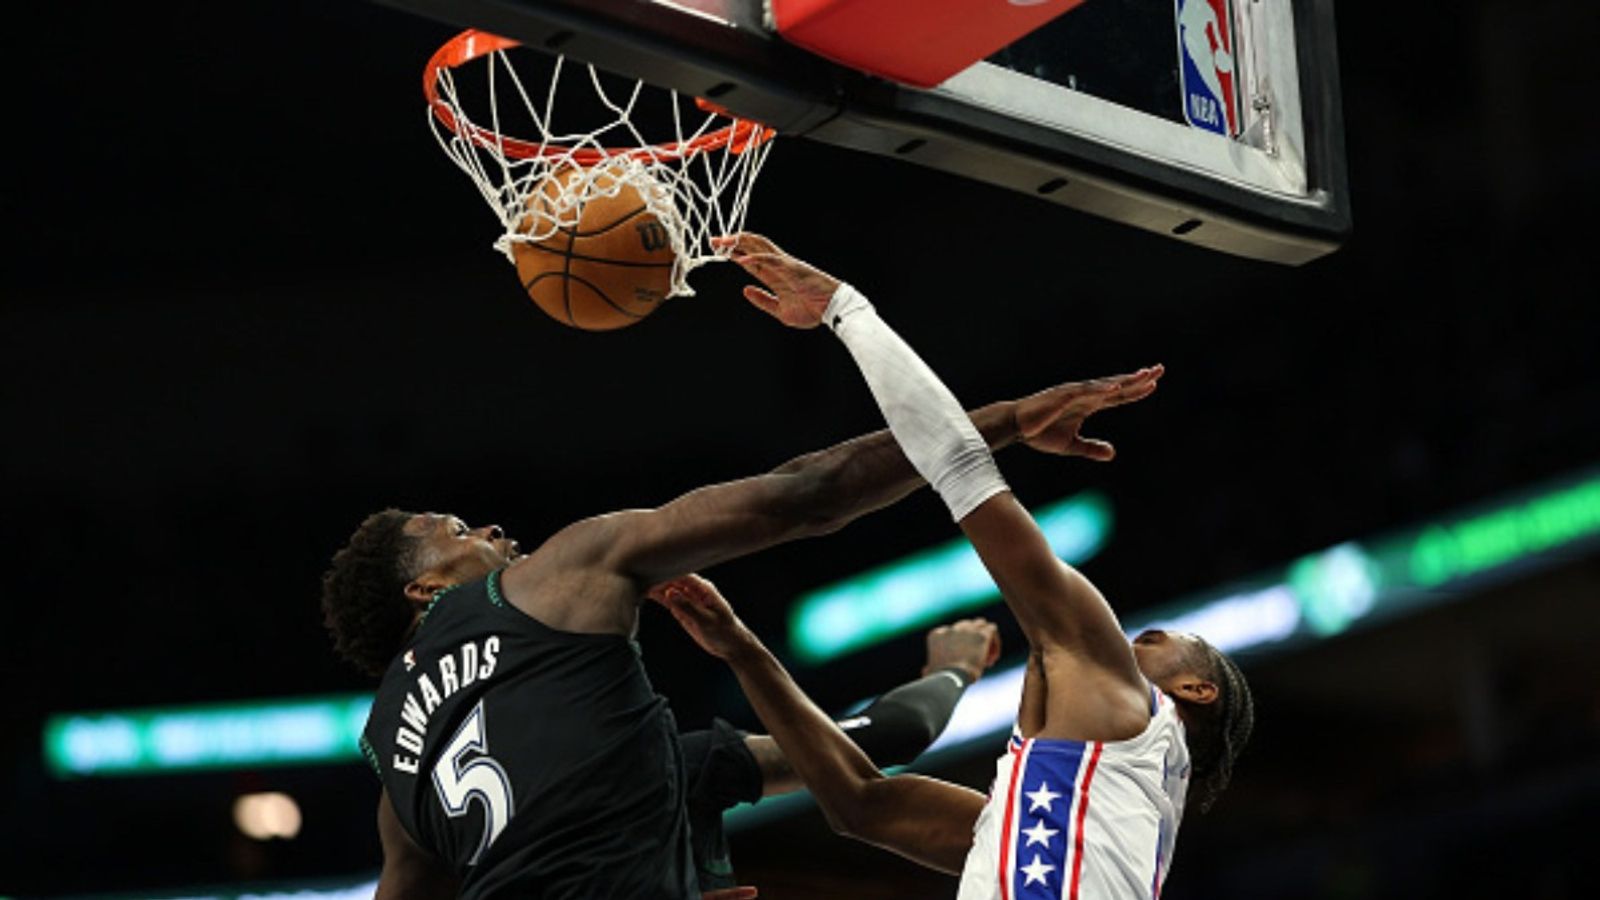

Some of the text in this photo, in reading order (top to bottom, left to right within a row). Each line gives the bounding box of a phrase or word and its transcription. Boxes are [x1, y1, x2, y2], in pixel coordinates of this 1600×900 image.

[1190, 93, 1219, 127] NBA
[393, 635, 500, 775] EDWARDS
[431, 698, 515, 866] 5
